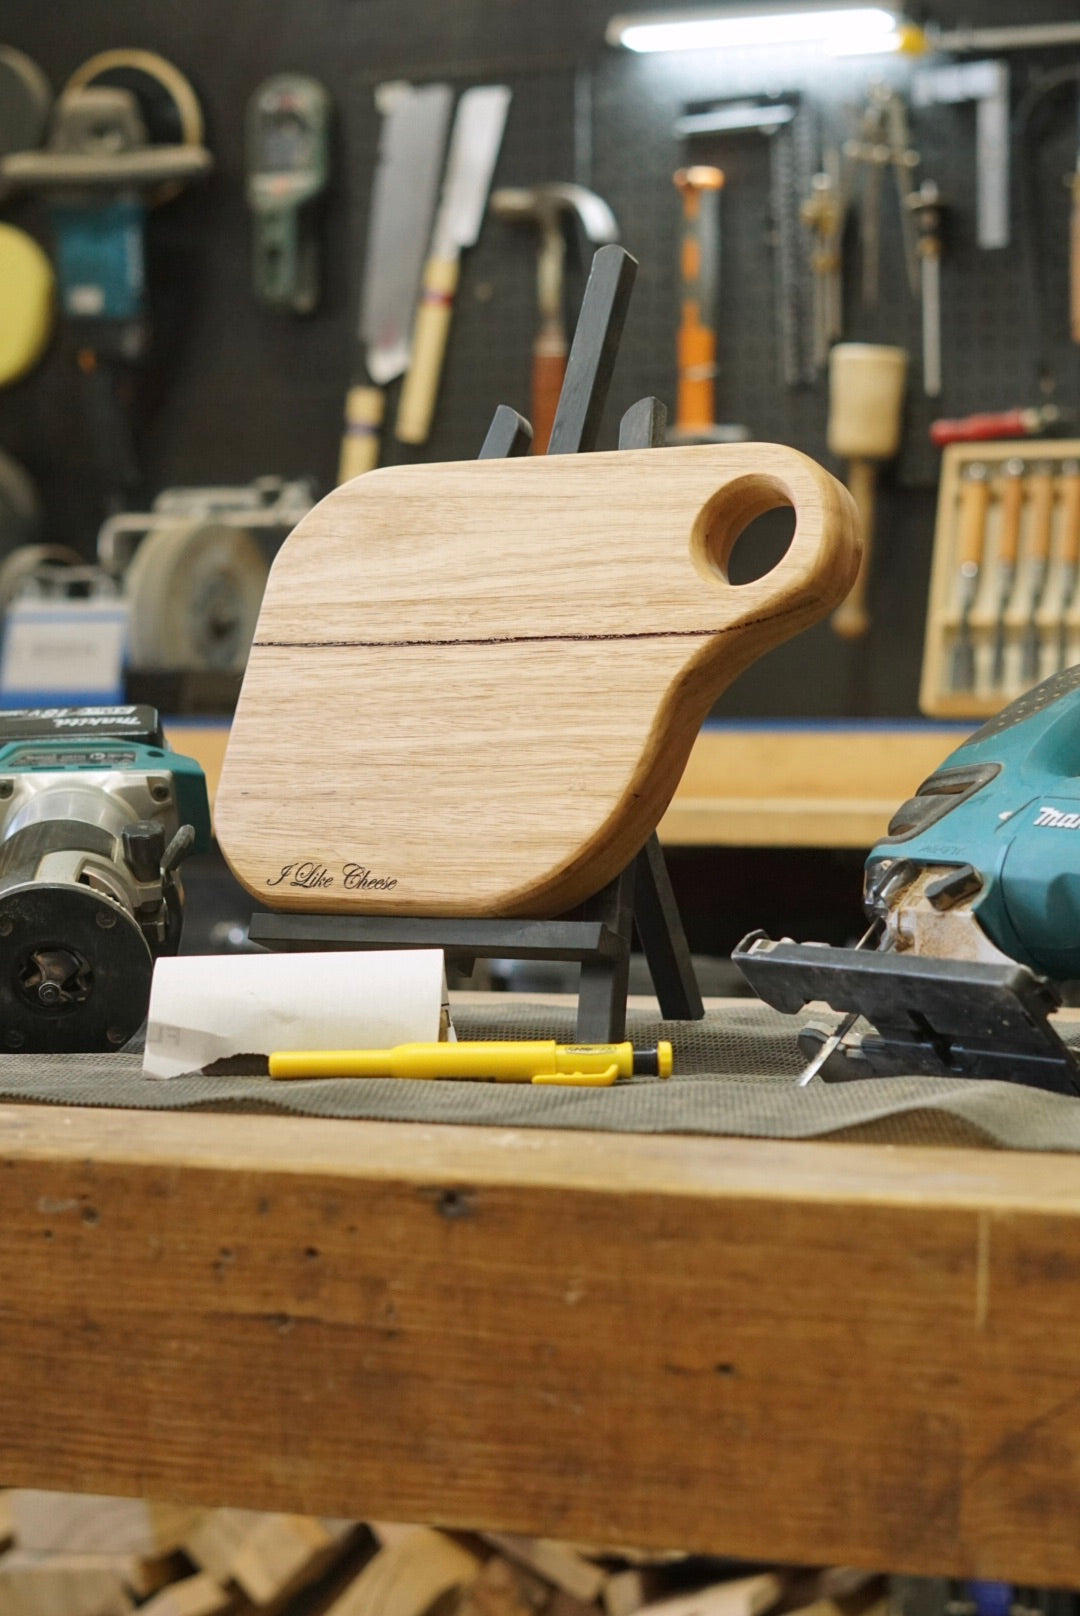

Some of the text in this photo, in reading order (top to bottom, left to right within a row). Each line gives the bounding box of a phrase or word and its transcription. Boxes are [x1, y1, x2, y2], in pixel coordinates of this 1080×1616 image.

[1033, 807, 1080, 829] ma
[266, 862, 398, 890] I Like Cheese
